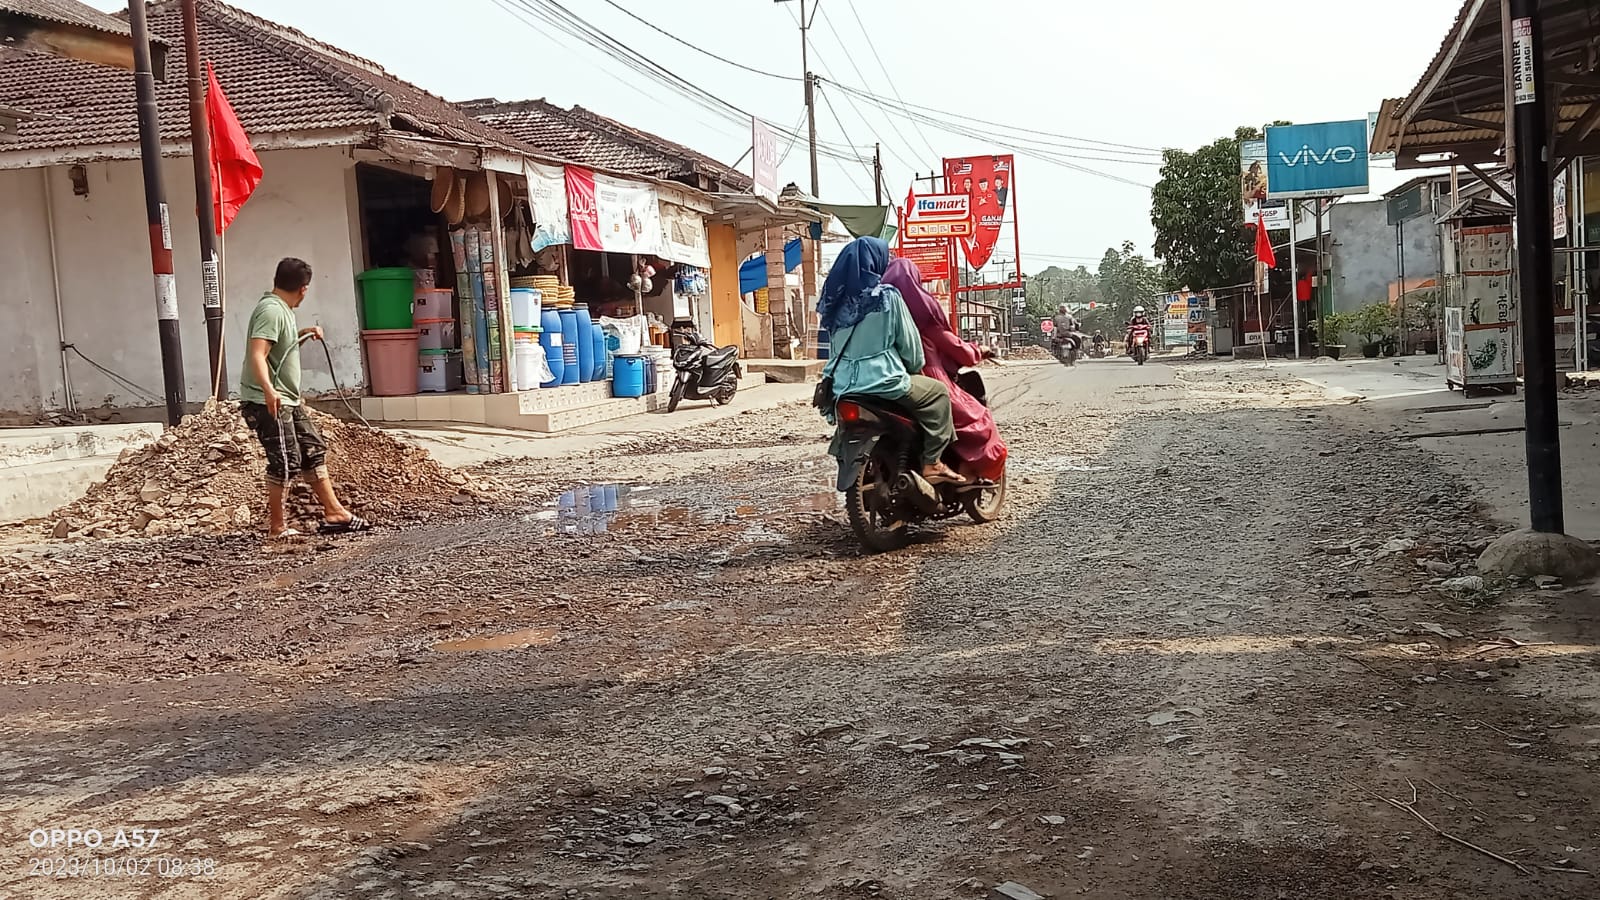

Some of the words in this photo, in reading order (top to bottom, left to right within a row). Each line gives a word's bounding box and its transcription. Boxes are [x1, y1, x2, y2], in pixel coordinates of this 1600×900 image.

[1512, 40, 1523, 90] BANNER
[1524, 46, 1532, 72] SRAGI
[1525, 73, 1532, 82] DI
[1279, 144, 1356, 167] vivo
[917, 199, 967, 210] lfamart
[1497, 294, 1508, 333] KEBB
